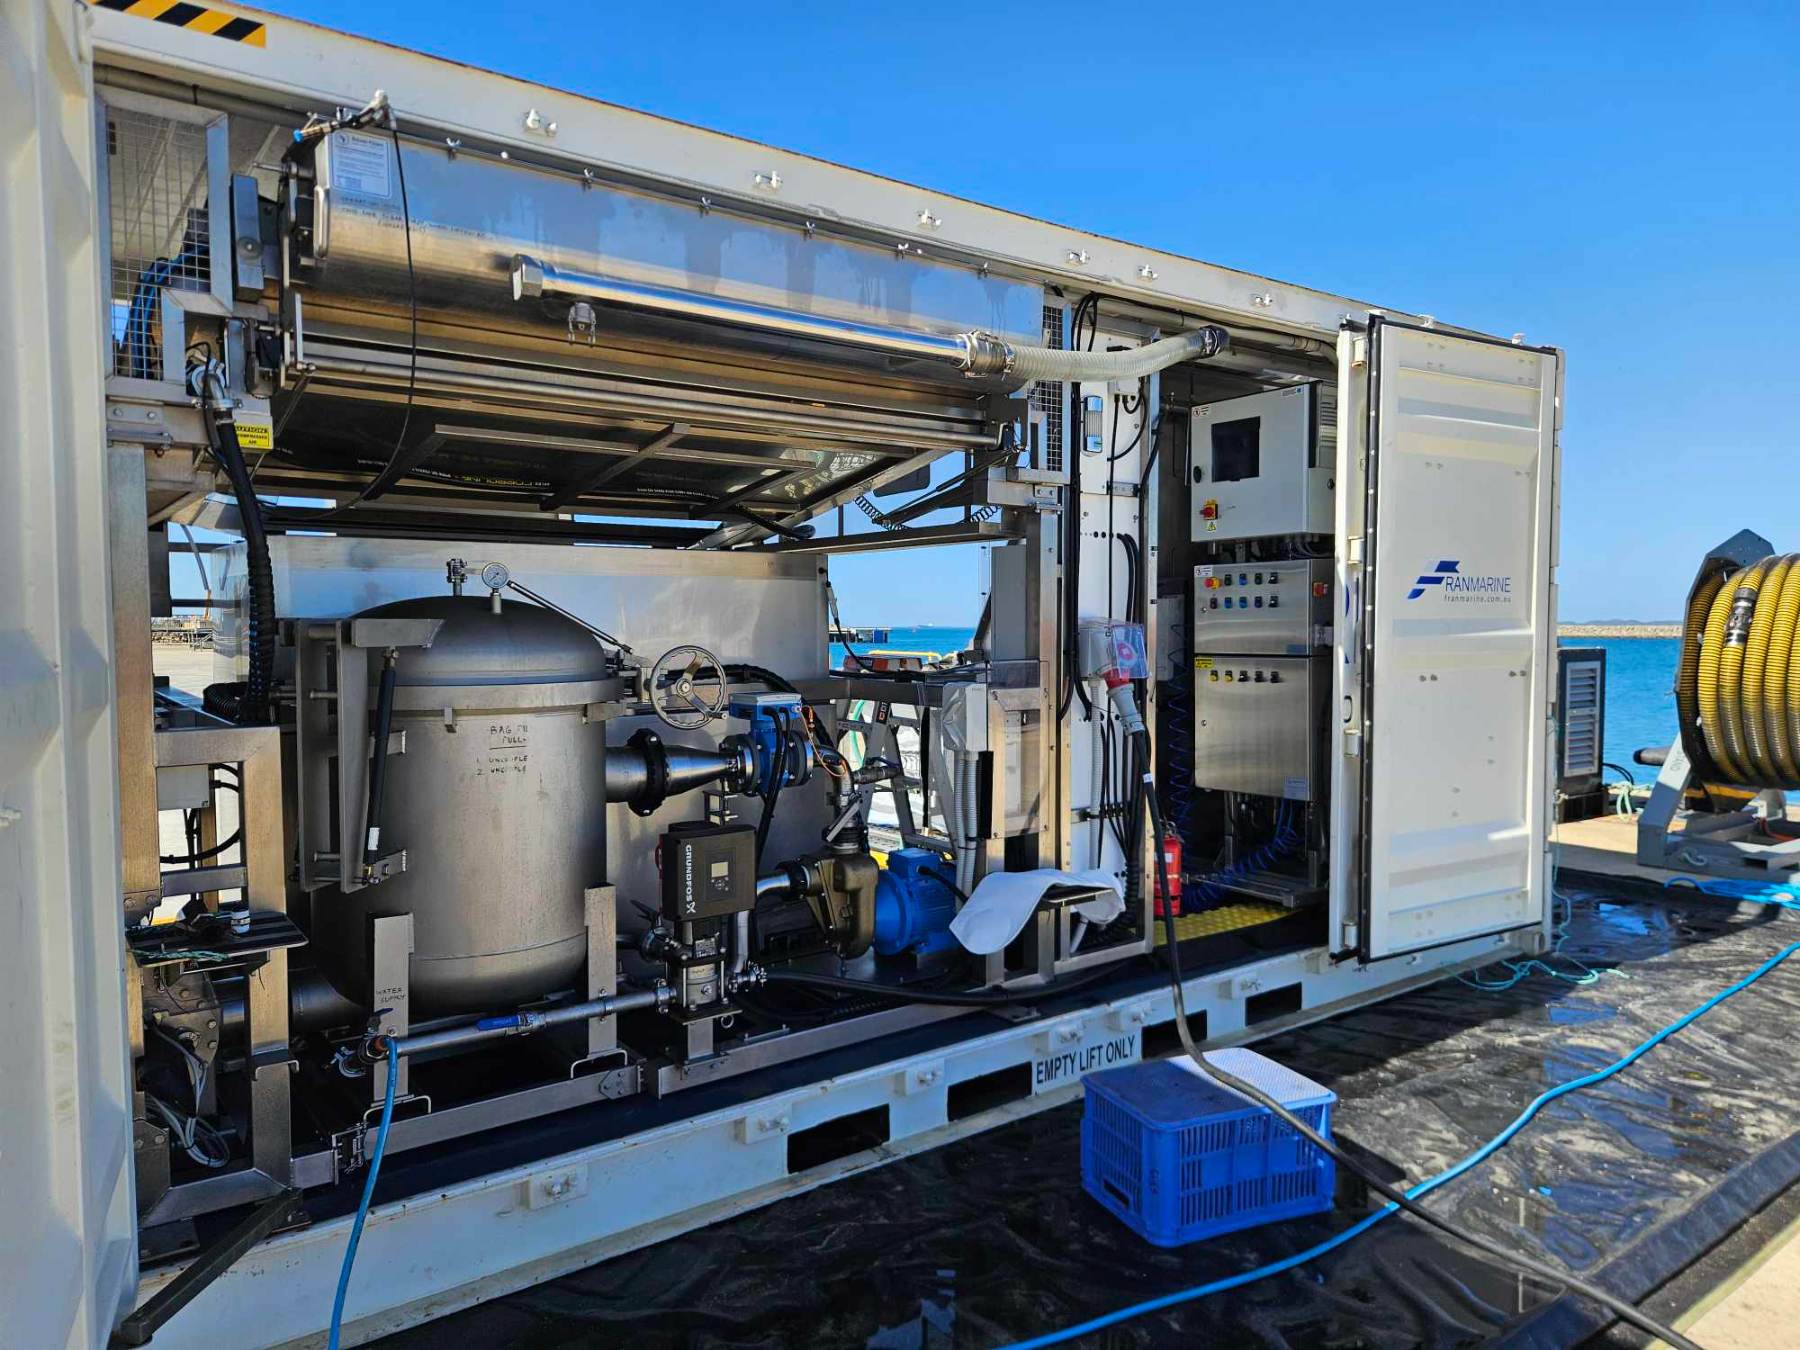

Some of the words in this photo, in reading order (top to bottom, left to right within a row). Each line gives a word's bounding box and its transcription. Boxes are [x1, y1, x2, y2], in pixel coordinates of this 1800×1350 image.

[490, 725, 512, 735] BAG
[685, 844, 693, 902] GRUNDFOS
[1036, 1050, 1077, 1084] EMPTY
[1080, 1045, 1103, 1071] LIFT
[1105, 1035, 1135, 1064] ONLY
